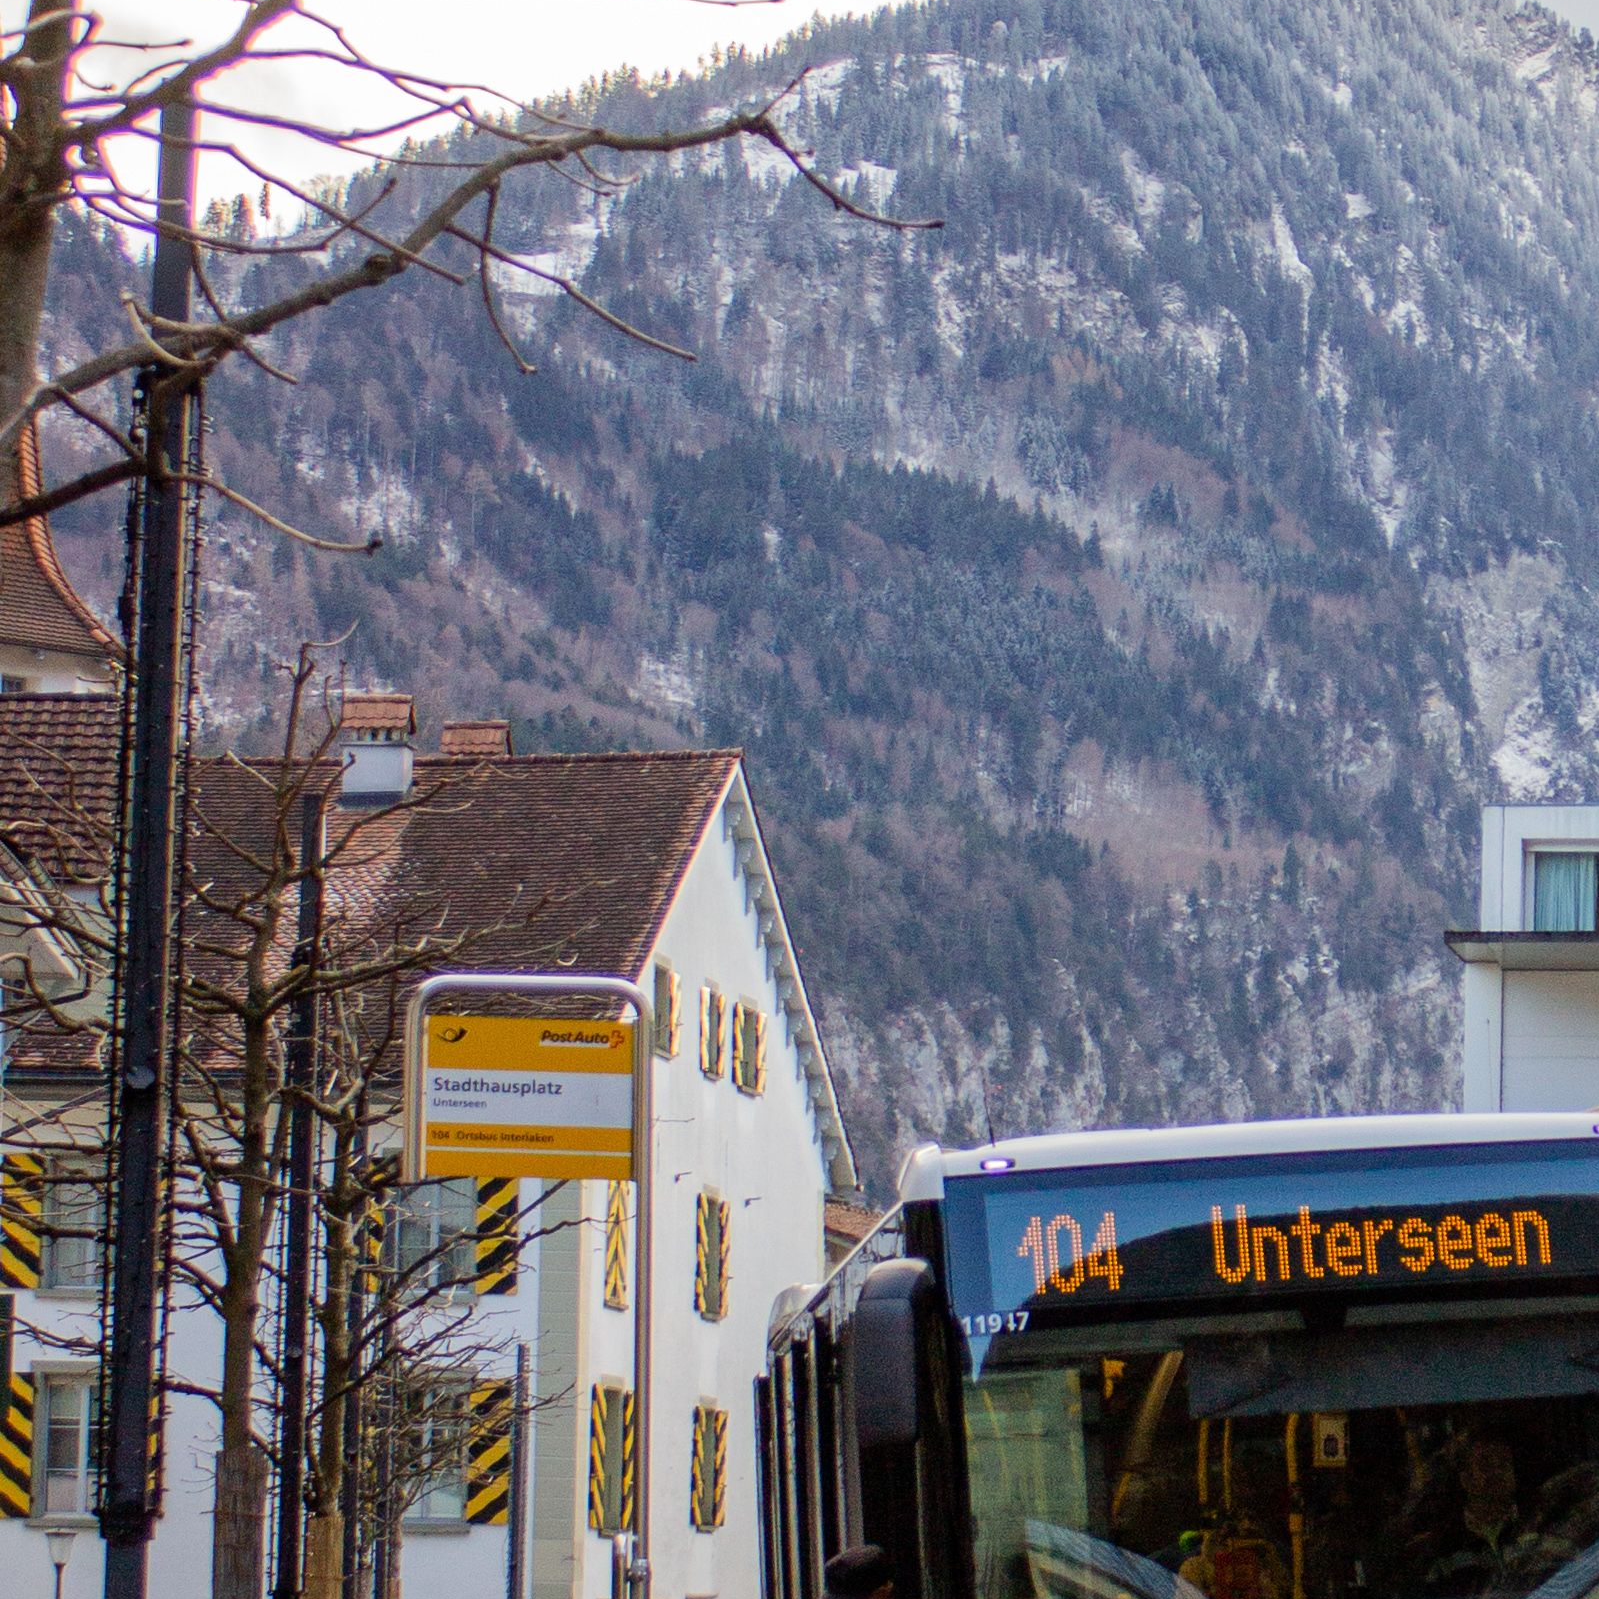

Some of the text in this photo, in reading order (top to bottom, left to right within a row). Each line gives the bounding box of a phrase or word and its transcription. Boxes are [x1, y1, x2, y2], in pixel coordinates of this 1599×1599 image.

[434, 1076, 563, 1097] Stadthausplatz
[433, 1097, 488, 1109] Unterseen
[1017, 1203, 1553, 1295] 104 Unterseen
